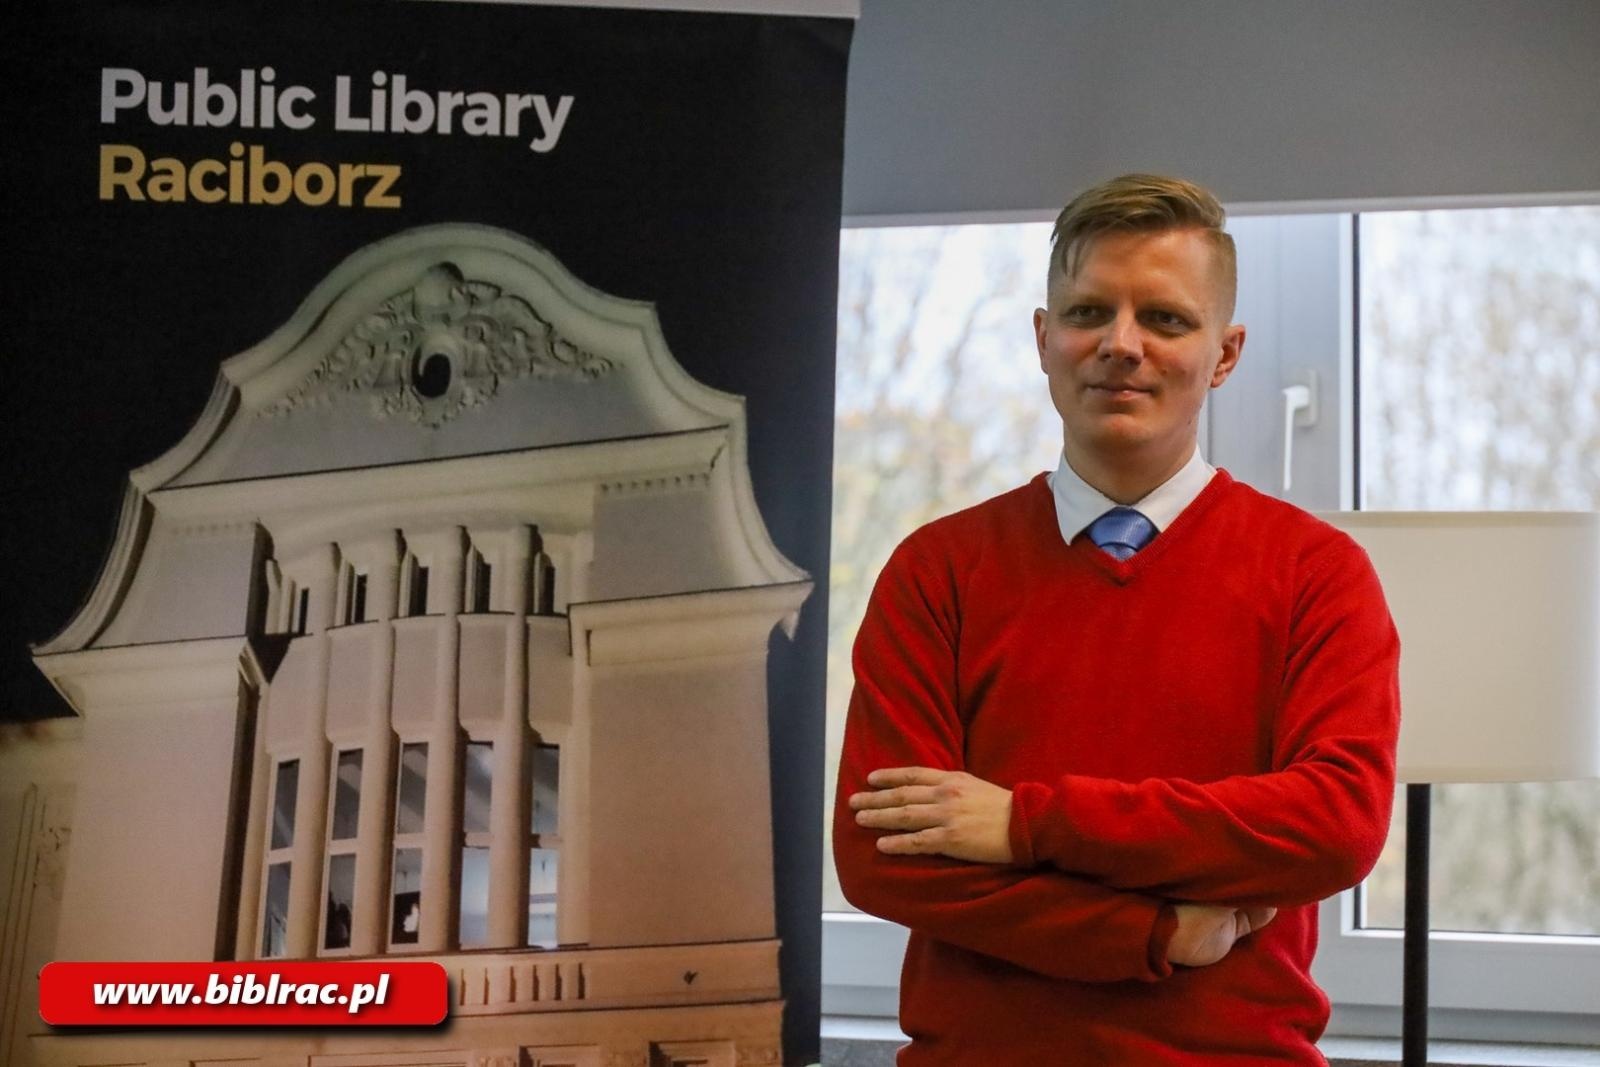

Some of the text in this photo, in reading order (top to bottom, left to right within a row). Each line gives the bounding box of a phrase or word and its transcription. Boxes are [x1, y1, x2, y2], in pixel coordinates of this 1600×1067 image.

[100, 66, 575, 154] Public Library
[98, 142, 402, 209] Raciborz
